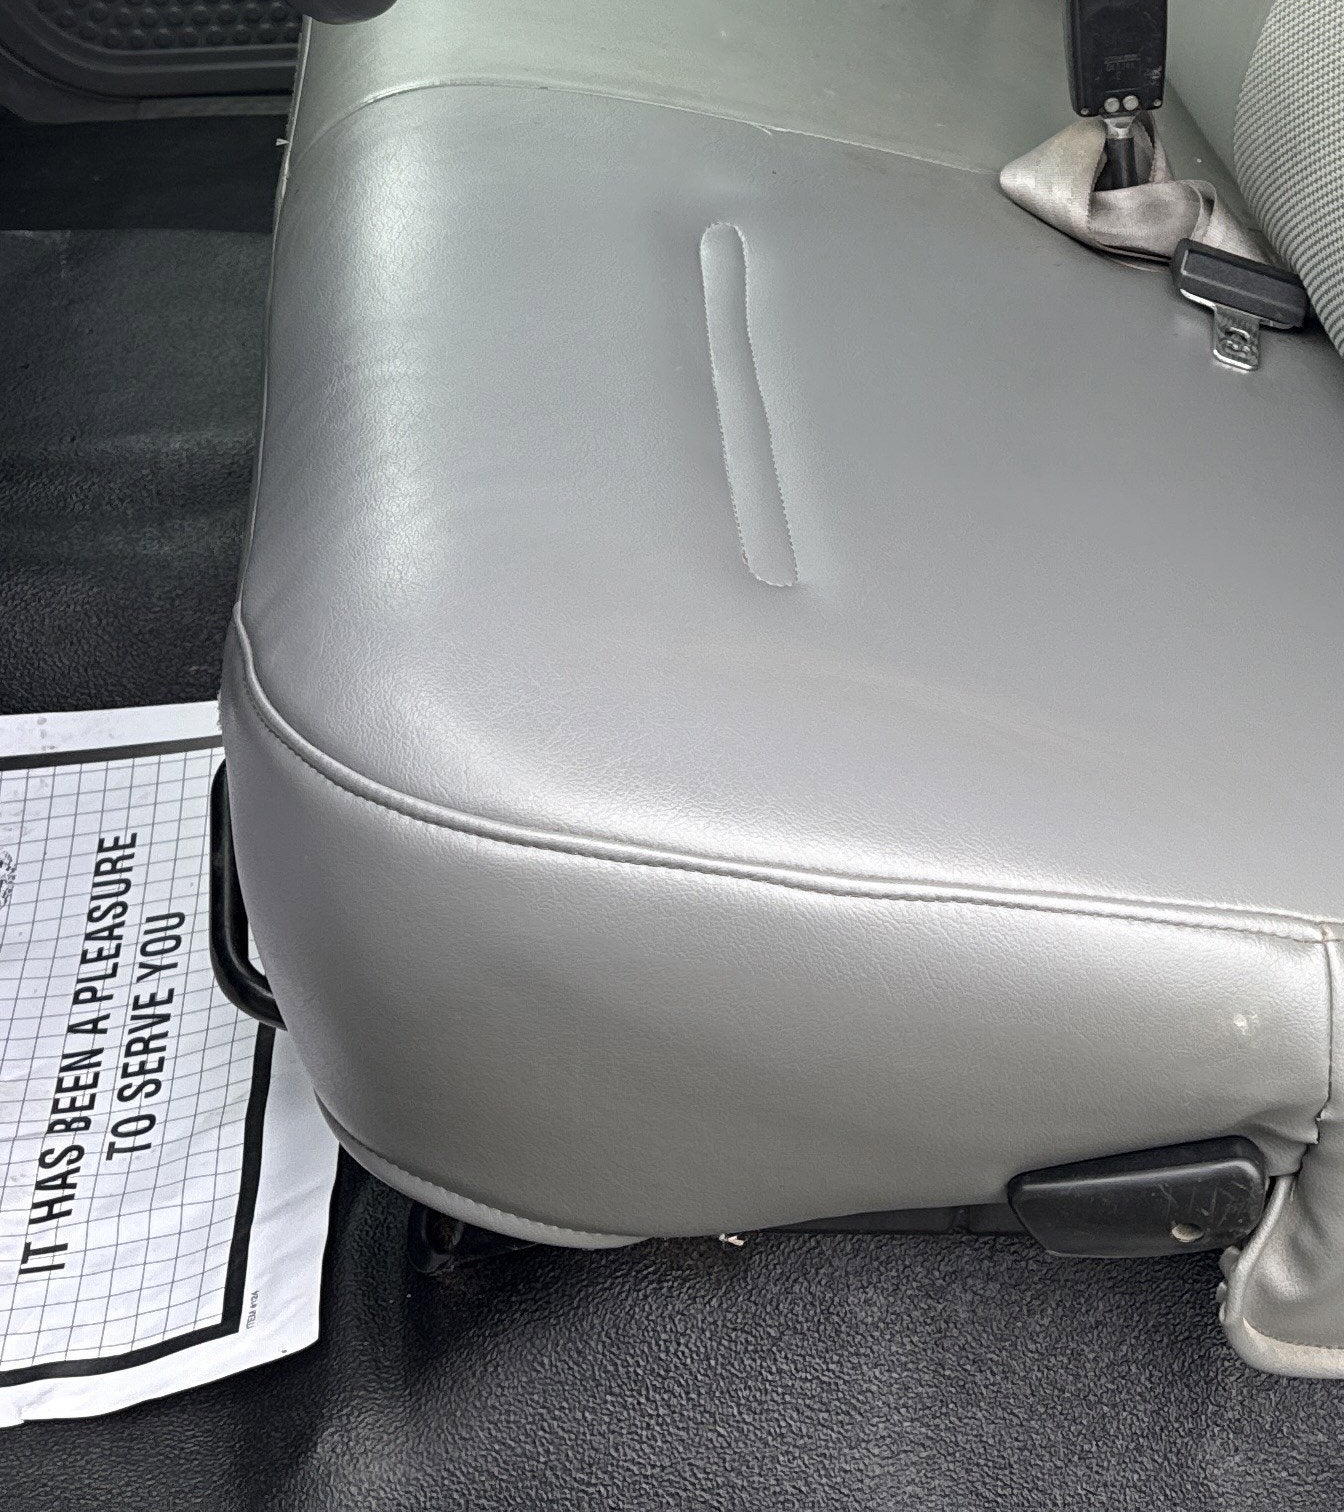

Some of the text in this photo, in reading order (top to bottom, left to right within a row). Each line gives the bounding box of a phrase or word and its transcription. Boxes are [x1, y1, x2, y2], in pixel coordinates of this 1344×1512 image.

[19, 831, 138, 1275] IT HAS BEEN A PLEASURE
[106, 910, 188, 1162] TO SERVE YOU
